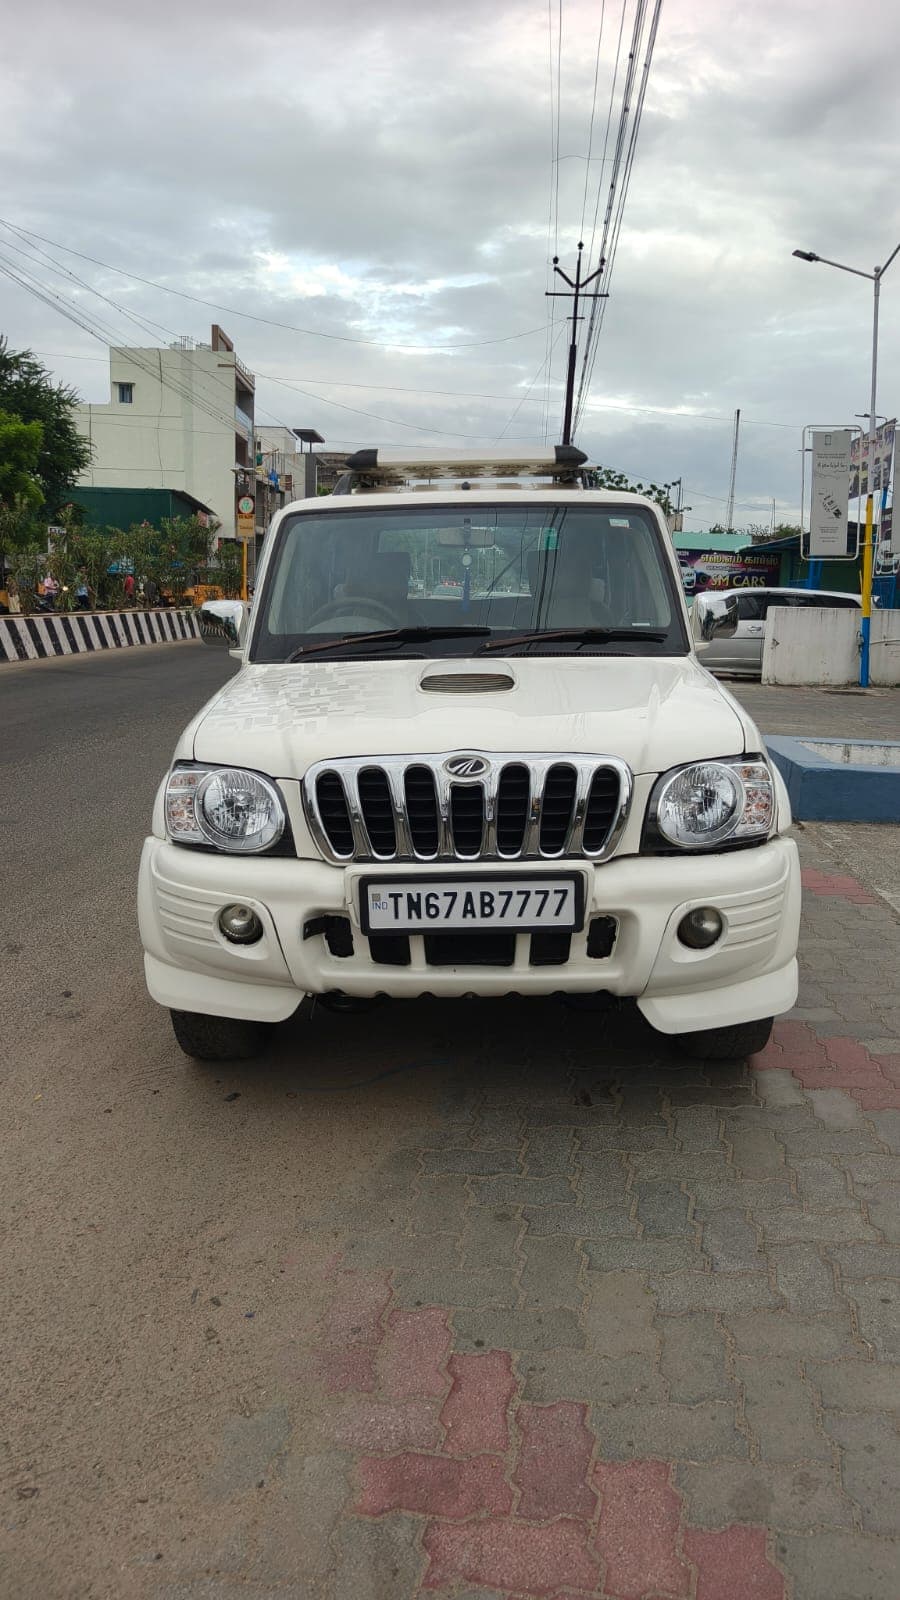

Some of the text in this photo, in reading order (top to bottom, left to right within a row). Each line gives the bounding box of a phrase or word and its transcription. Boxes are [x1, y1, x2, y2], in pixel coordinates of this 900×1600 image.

[711, 574, 766, 587] SM CARS
[372, 889, 569, 920] IND TN67AB7777
